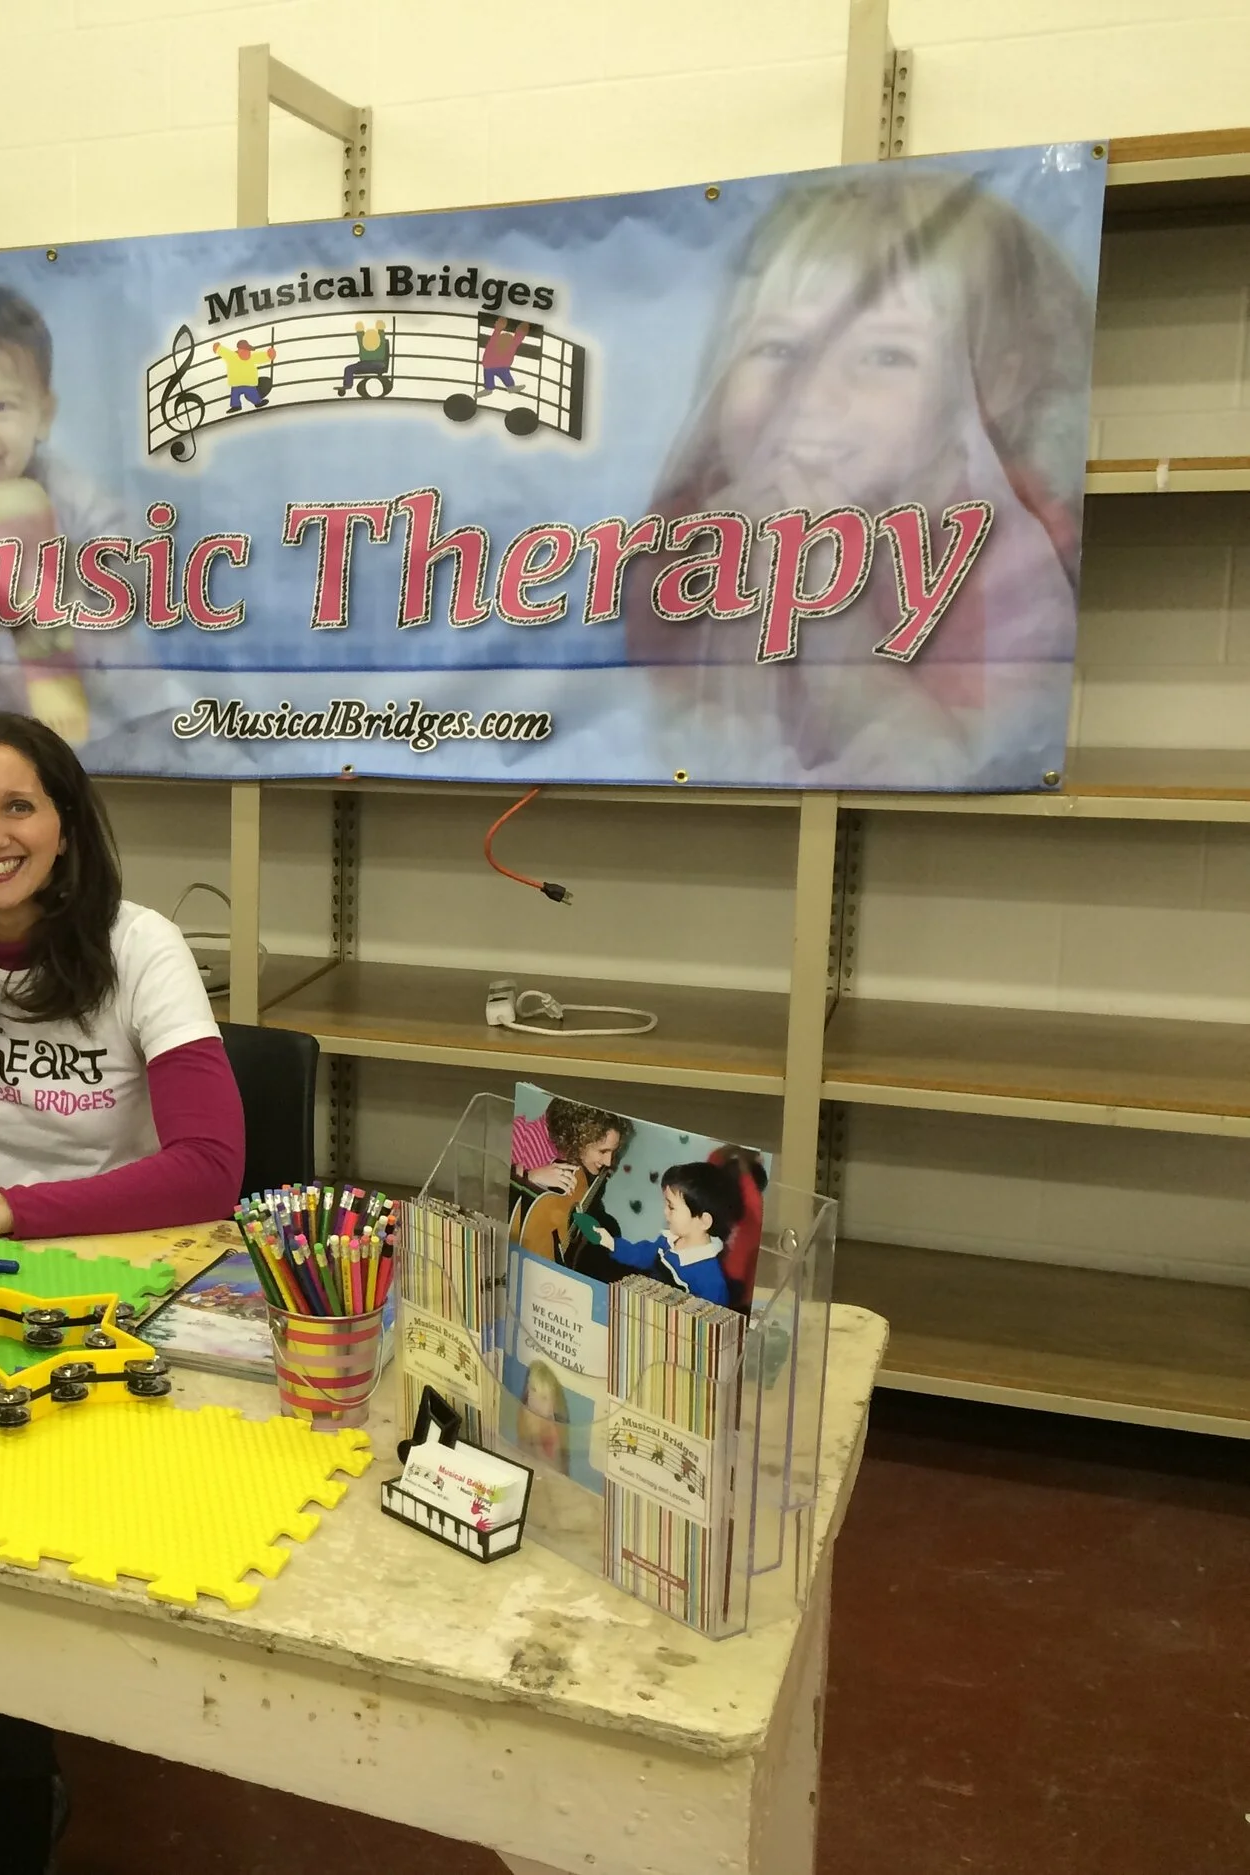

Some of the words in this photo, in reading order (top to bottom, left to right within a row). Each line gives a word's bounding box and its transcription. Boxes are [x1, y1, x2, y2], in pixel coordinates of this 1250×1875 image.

[204, 266, 373, 326] Musical
[386, 265, 555, 311] Bridges
[283, 485, 995, 664] Therapy
[172, 697, 552, 752] MusicalBridges.com
[414, 1316, 443, 1335] Musical
[531, 1302, 547, 1318] WE
[547, 1311, 571, 1329] CALL
[573, 1322, 584, 1334] IT
[534, 1329, 553, 1346] THE
[554, 1340, 578, 1358] KIDS
[561, 1355, 586, 1375] PLAY
[621, 1416, 661, 1438] Musical
[662, 1431, 700, 1463] Bridges
[438, 1464, 466, 1483] Musical
